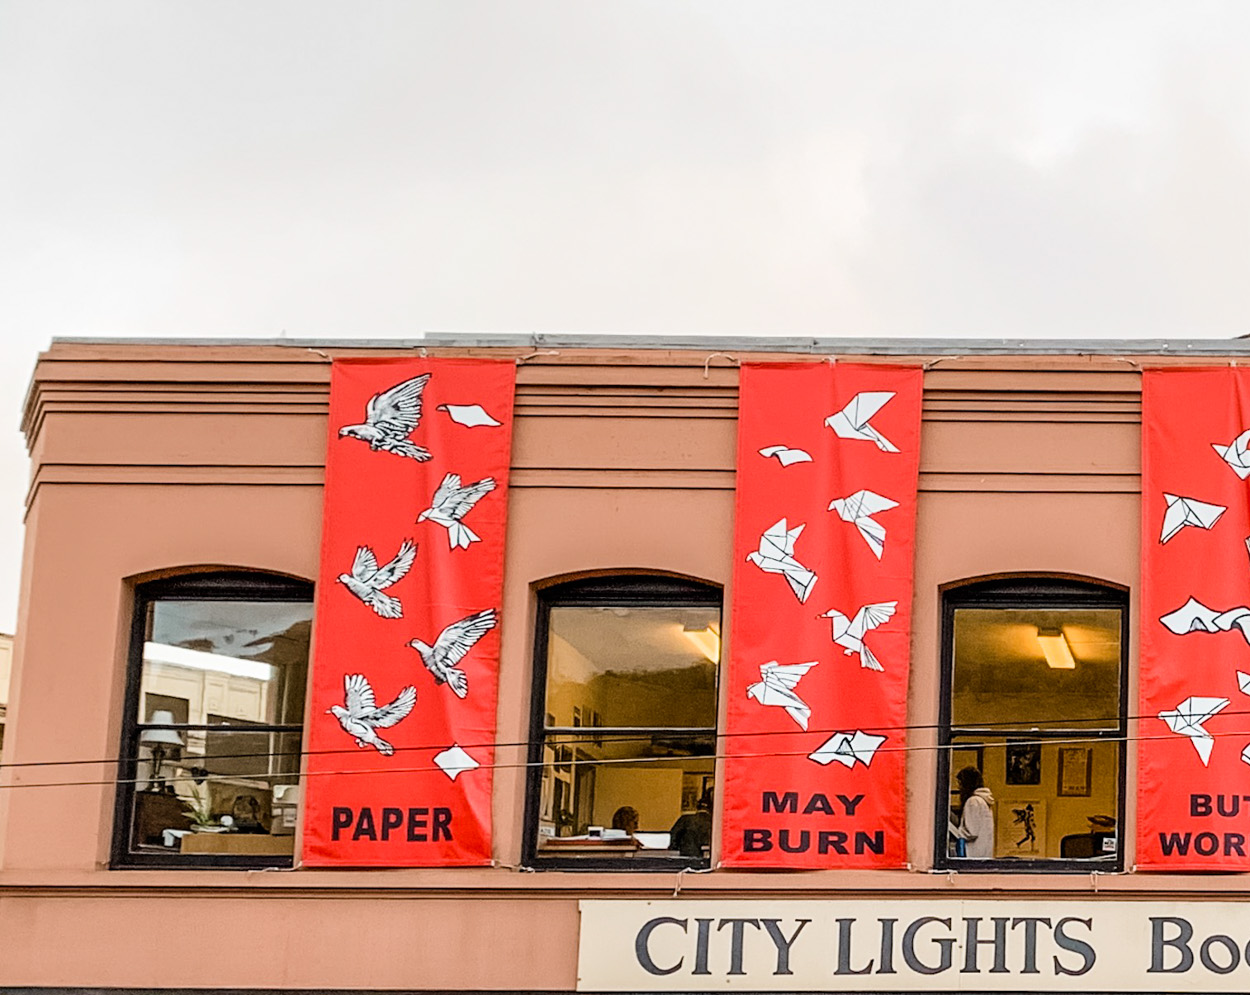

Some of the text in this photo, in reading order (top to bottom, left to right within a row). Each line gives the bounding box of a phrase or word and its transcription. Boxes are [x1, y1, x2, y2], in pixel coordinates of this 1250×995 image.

[762, 791, 865, 816] MAY
[331, 806, 453, 842] PAPER
[742, 829, 885, 856] BURN
[635, 917, 812, 976] CITY
[833, 917, 1096, 977] LIGHTS
